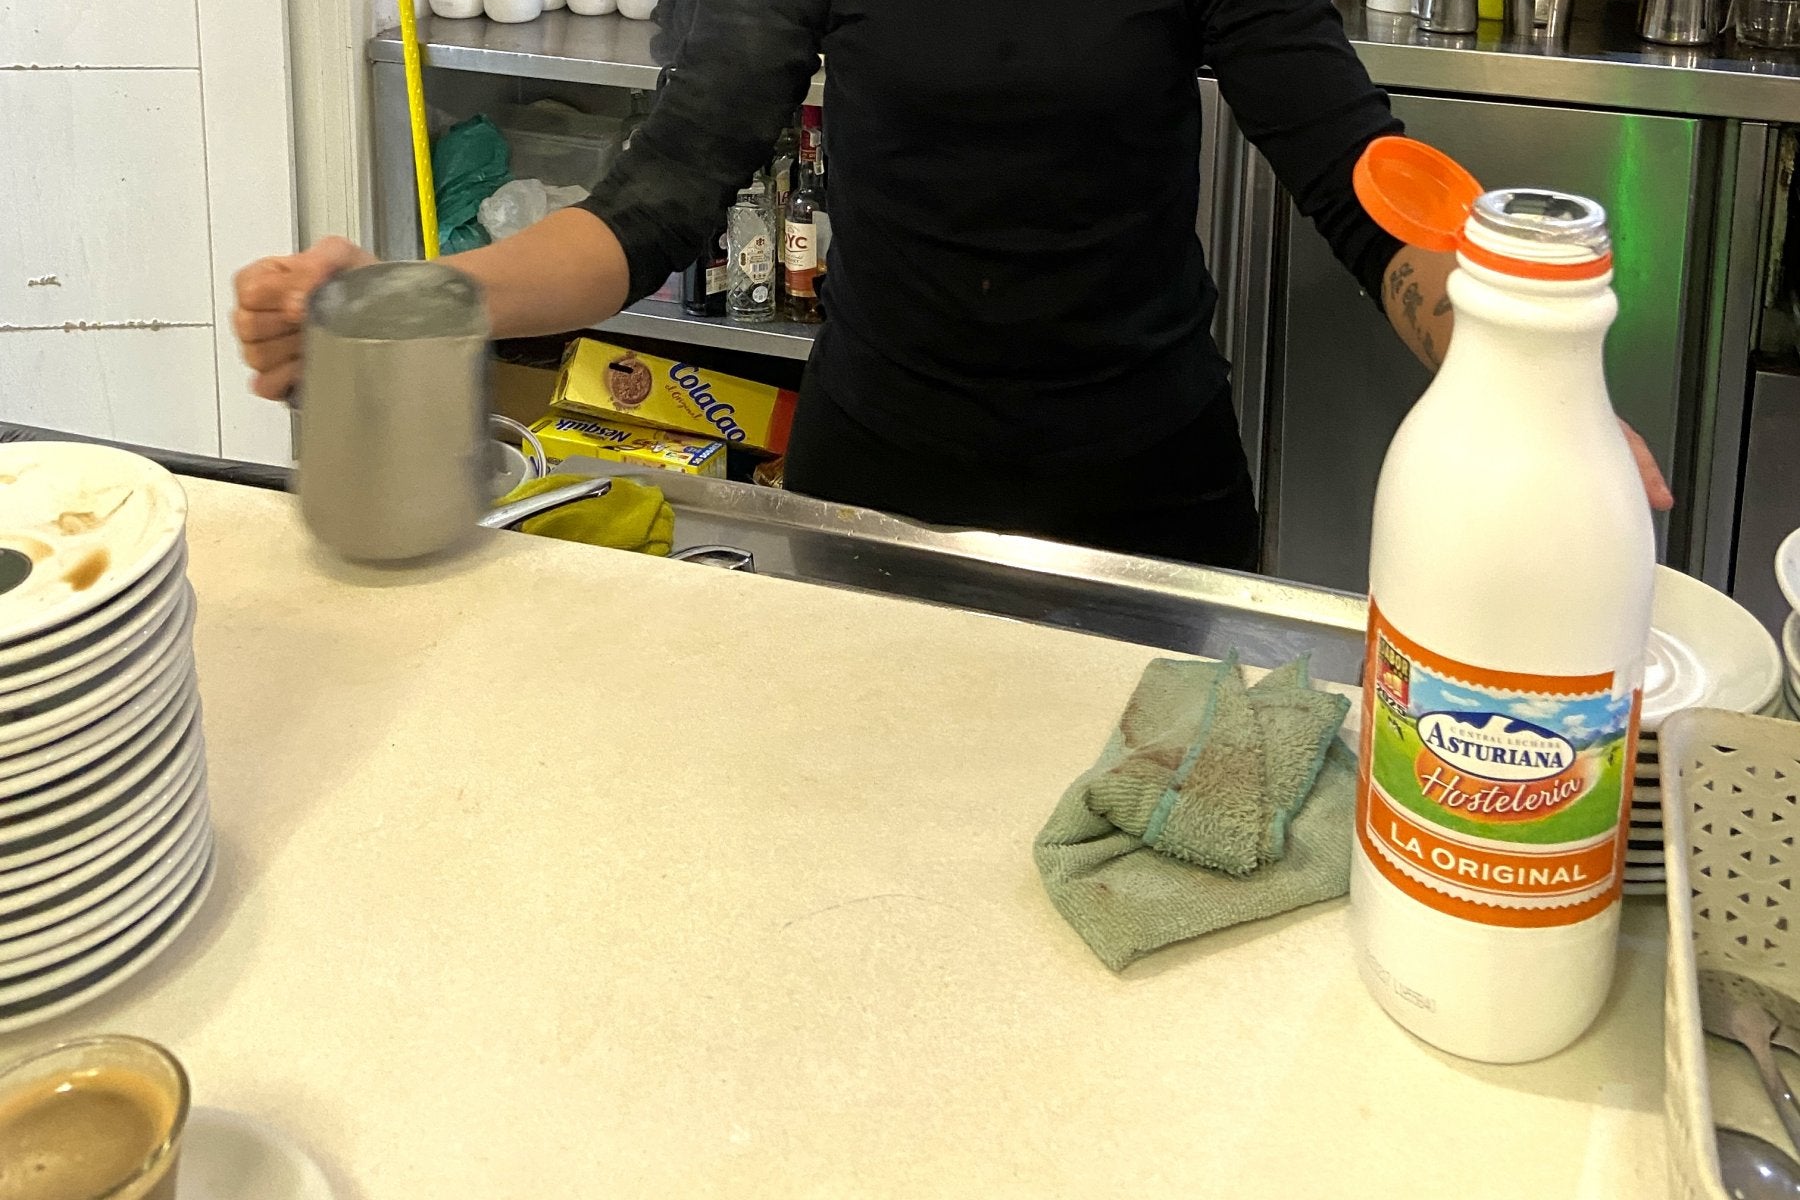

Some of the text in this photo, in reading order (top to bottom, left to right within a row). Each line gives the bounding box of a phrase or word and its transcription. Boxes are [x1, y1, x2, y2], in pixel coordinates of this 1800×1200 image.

[668, 361, 747, 443] ColaCao
[556, 419, 632, 443] Nesquik
[1425, 721, 1564, 769] ASTURIANA
[1449, 725, 1502, 745] CENTRAL
[1390, 821, 1588, 886] LA ORIGINAL
